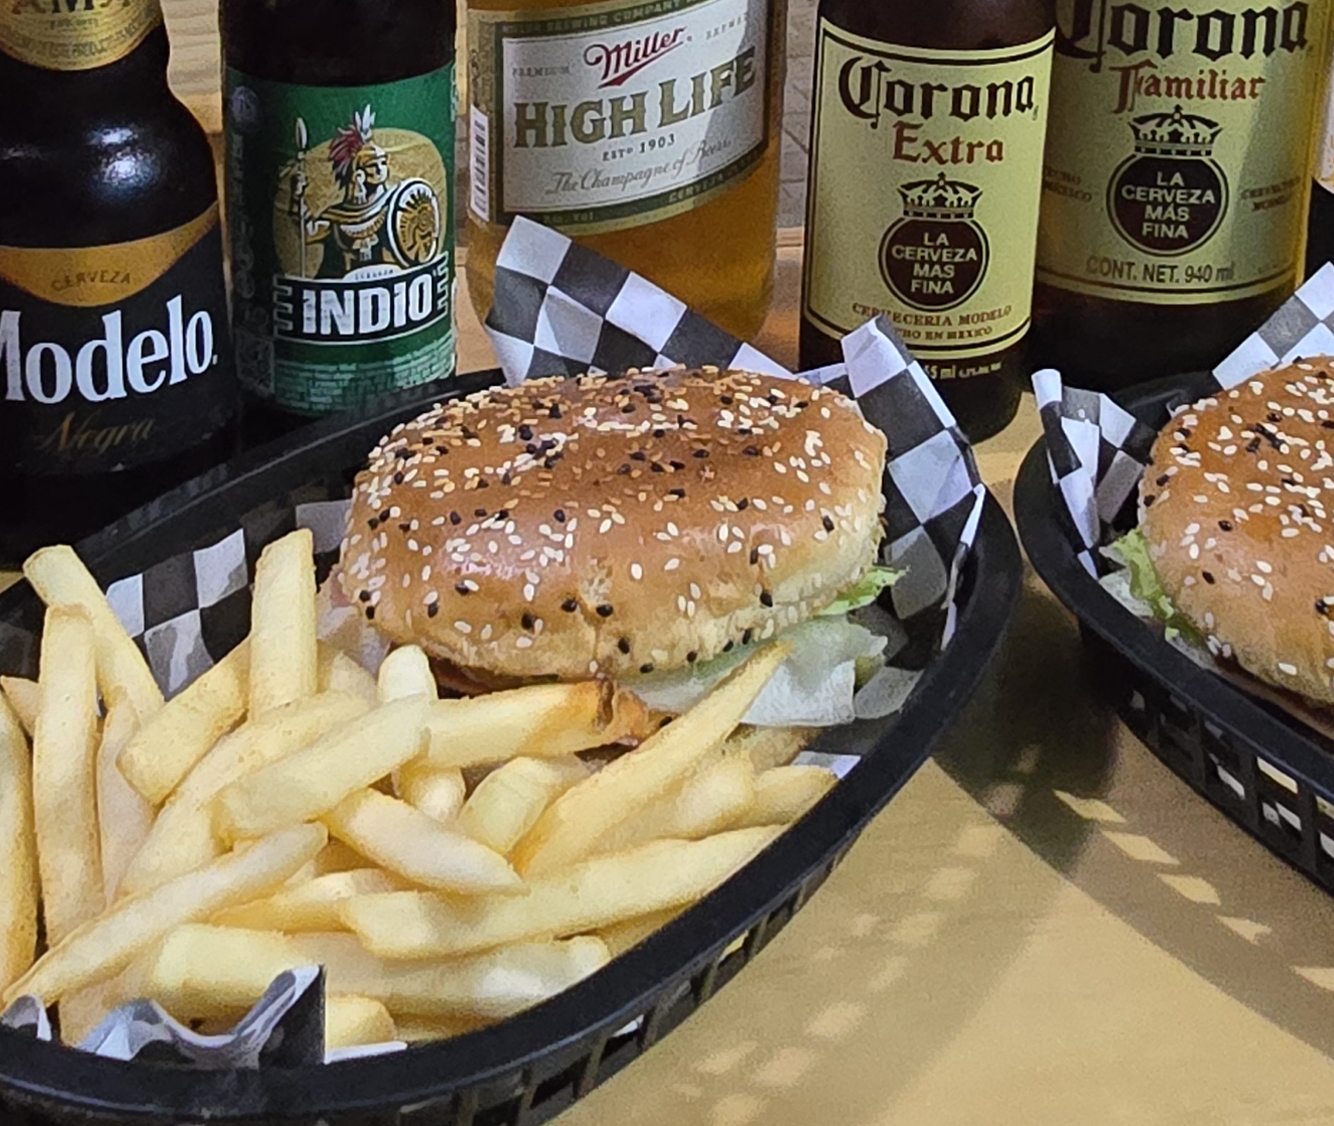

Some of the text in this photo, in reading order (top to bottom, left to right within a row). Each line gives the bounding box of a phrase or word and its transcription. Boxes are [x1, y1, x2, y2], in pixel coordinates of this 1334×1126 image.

[583, 25, 688, 84] Miller
[513, 45, 757, 149] HIGH LIFE
[838, 55, 1035, 130] Corona
[1109, 59, 1266, 114] Familiar
[639, 132, 676, 154] 1903
[892, 120, 1004, 165] Extra
[1157, 171, 1184, 186] LA
[1121, 185, 1216, 204] CERVEZA
[1144, 204, 1190, 221] MÁS
[924, 233, 950, 246] LA
[1142, 223, 1189, 239] FINA
[891, 245, 978, 262] CERVEZA
[913, 263, 955, 278] MAS
[1086, 256, 1136, 274] CONT.
[1143, 264, 1180, 283] NET.
[1184, 264, 1213, 283] 940
[51, 271, 131, 292] CERVEZA
[911, 279, 954, 294] FINA
[302, 273, 435, 336] INDIO
[958, 304, 1012, 325] MODELO
